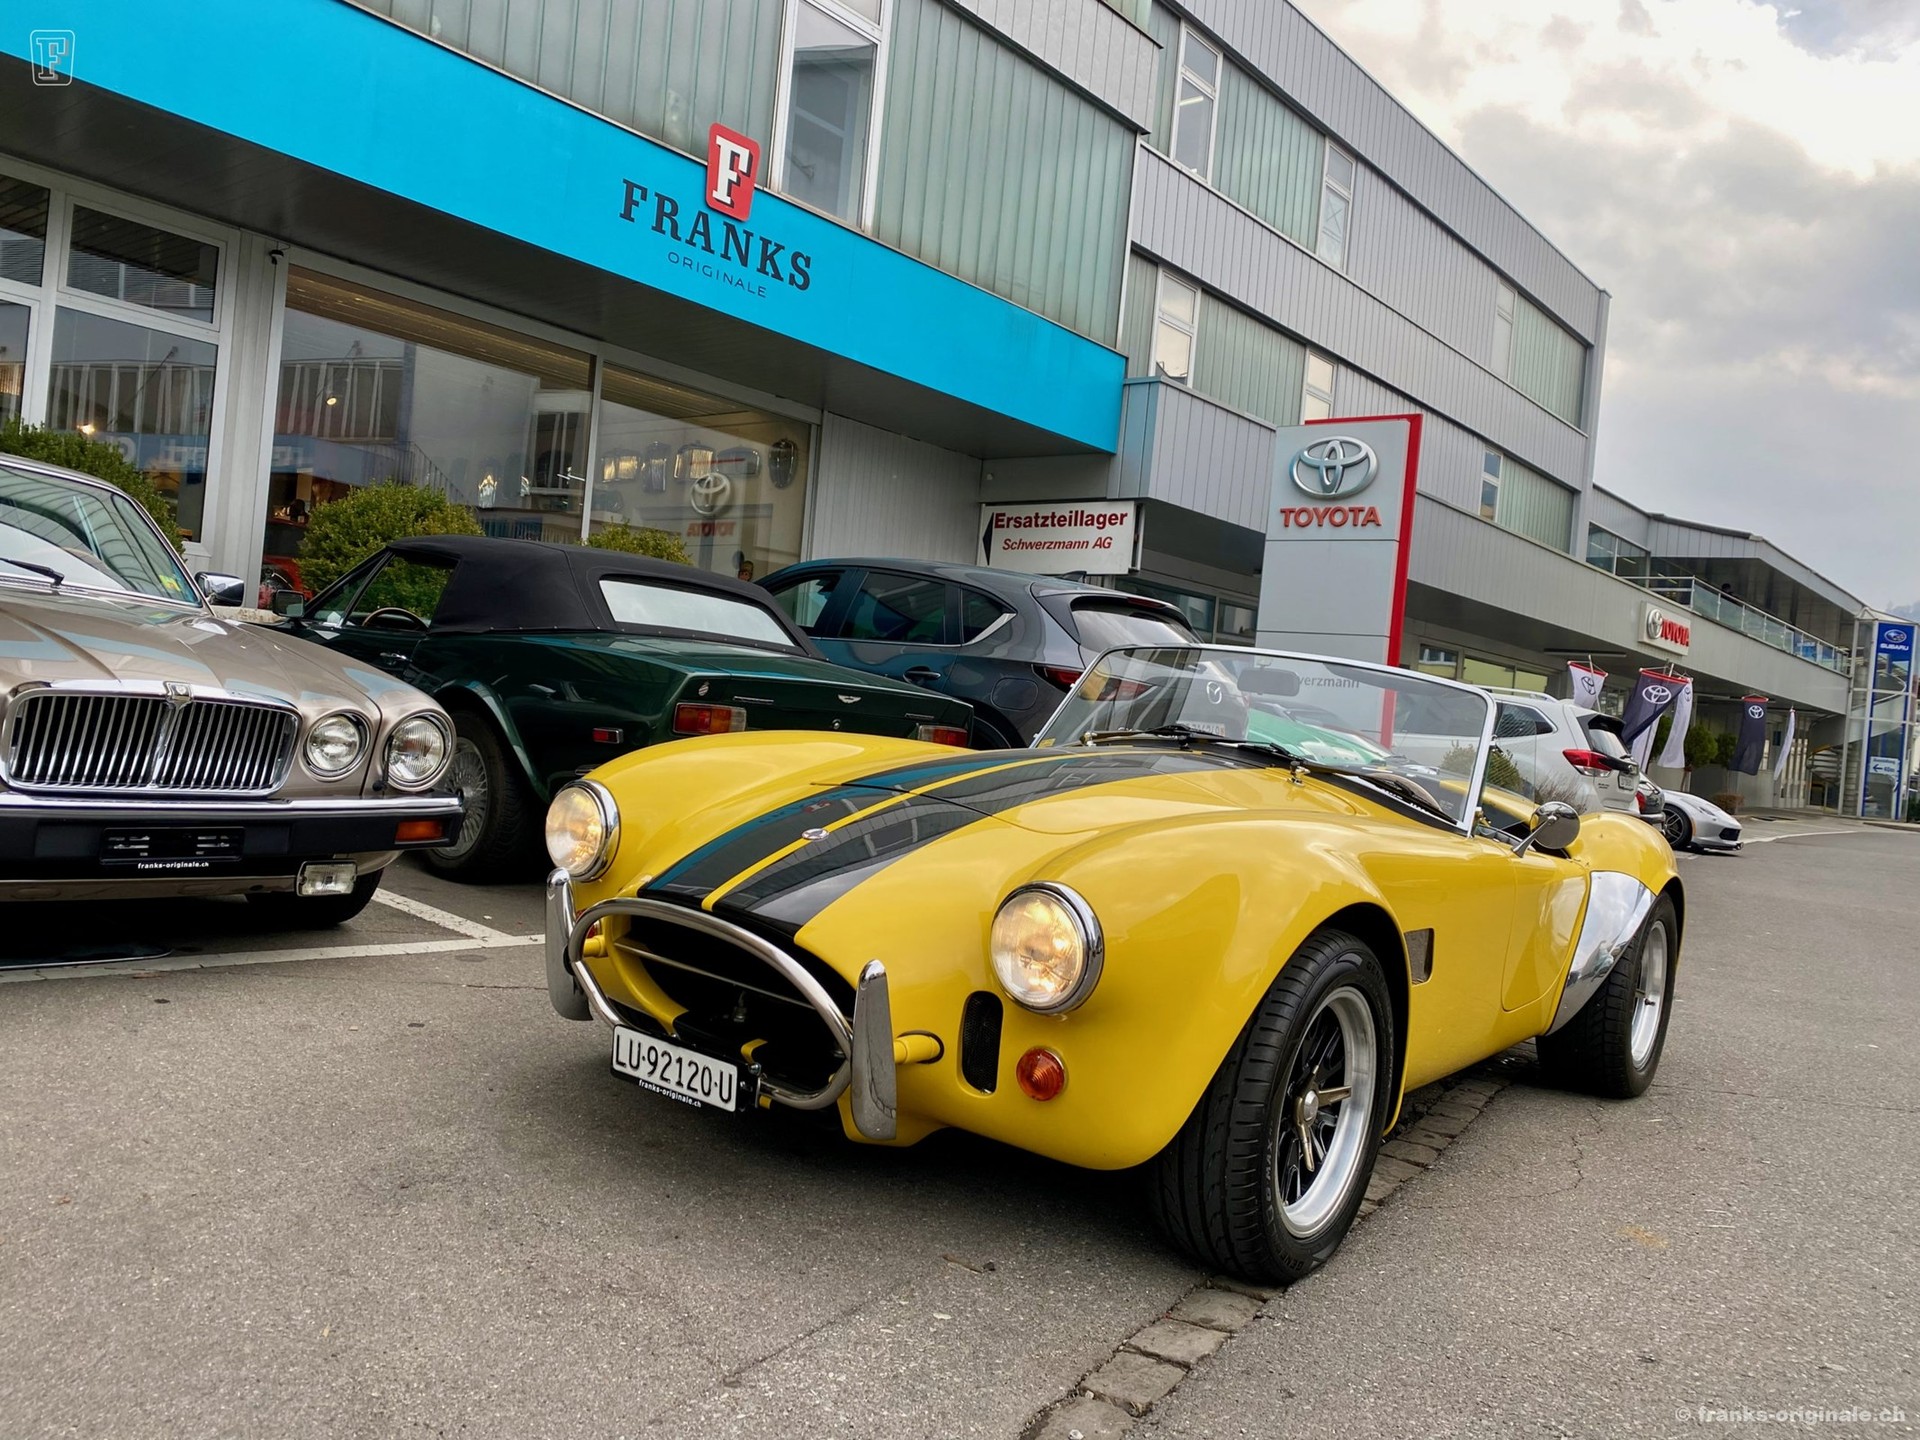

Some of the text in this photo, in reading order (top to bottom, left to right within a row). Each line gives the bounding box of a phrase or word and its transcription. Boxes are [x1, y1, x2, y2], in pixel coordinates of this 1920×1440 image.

[712, 135, 754, 208] F
[619, 178, 812, 291] FRANKS
[667, 251, 767, 298] ORIGINALE
[994, 510, 1127, 529] Ersatzteillager
[1280, 506, 1382, 527] TOYOTA
[1002, 537, 1113, 550] Schwerzmann AG
[137, 861, 209, 869] franks-originale.ch
[638, 1079, 702, 1108] franks-originale.ch
